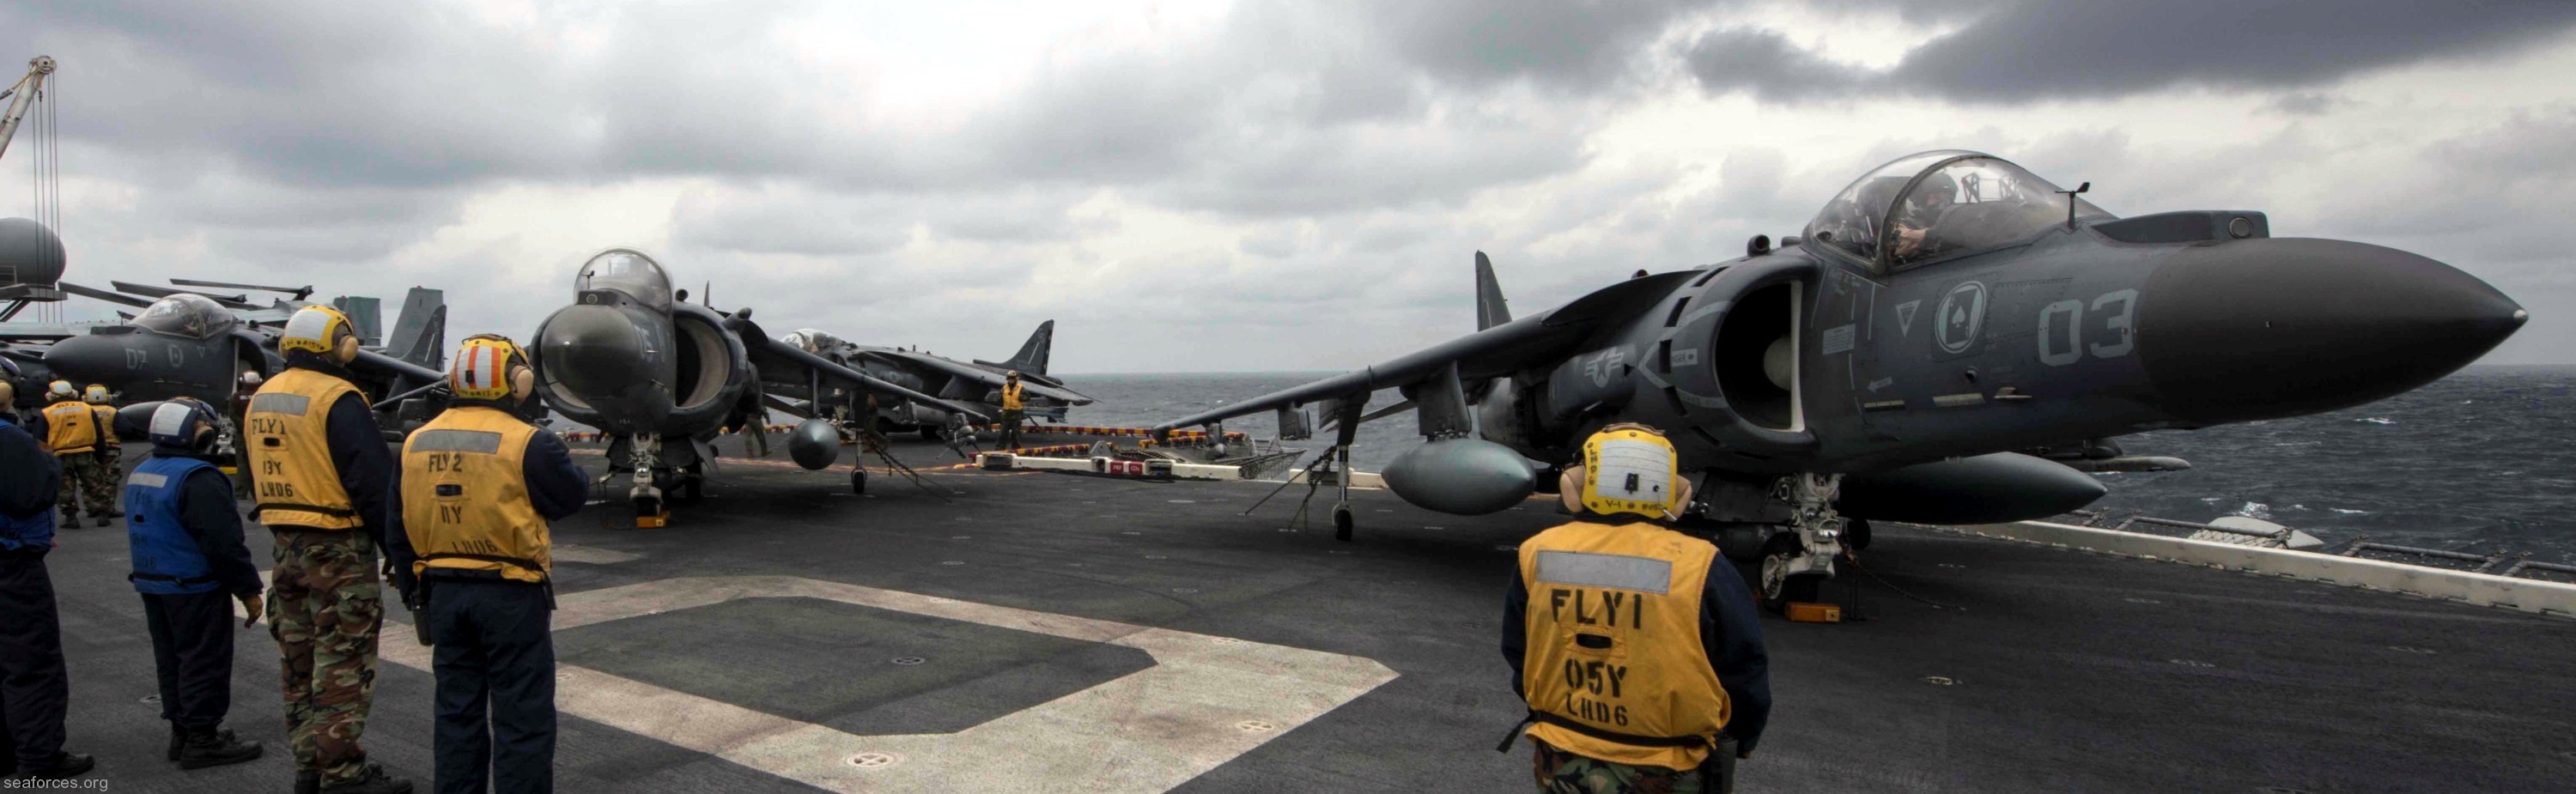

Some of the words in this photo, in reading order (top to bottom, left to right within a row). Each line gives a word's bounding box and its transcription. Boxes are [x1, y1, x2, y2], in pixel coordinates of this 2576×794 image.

[2038, 288, 2140, 367] 03
[260, 482, 294, 497] LHD6
[1564, 658, 1627, 698] 05Y
[1566, 693, 1628, 726] LHD6
